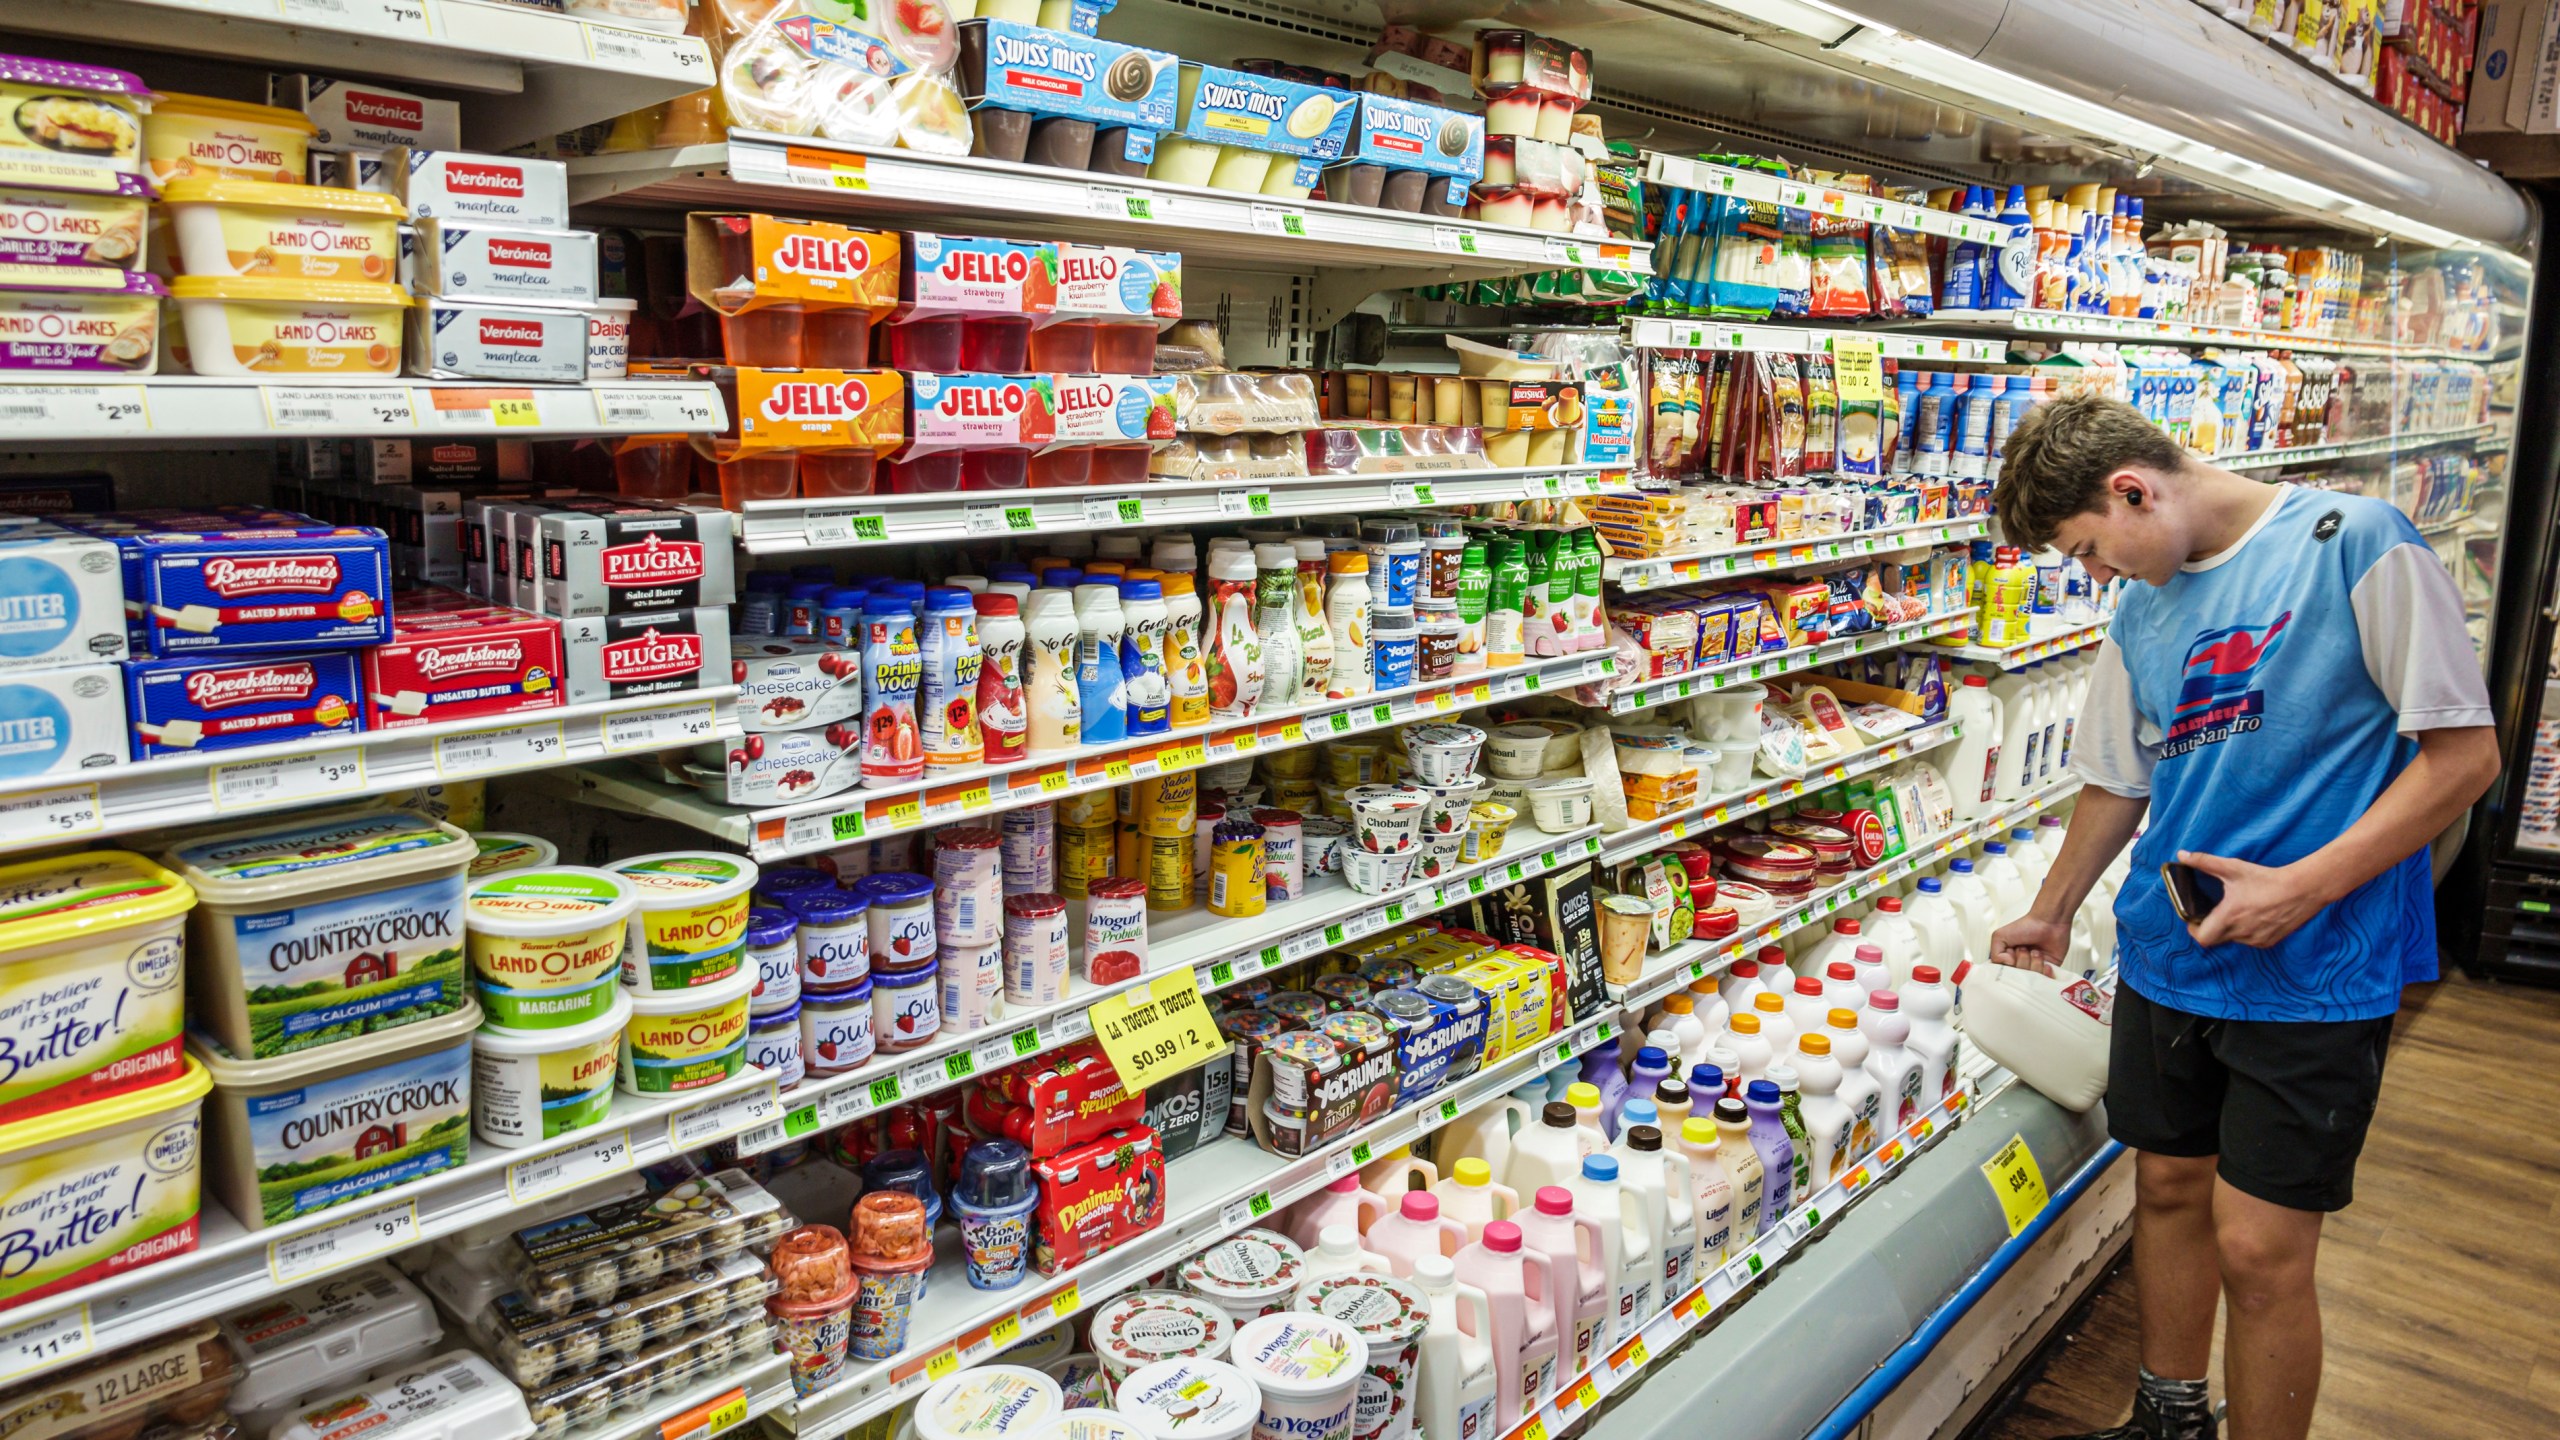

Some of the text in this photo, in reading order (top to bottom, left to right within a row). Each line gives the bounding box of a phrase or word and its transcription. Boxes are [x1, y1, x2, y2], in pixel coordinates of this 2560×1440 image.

[592, 26, 678, 47] PHILADELPHIA SALMON
[816, 29, 872, 68] Nata Pudding
[994, 34, 1096, 82] SWISS MISS
[1022, 77, 1068, 91] MILK CHOCOLATE
[347, 99, 422, 122] Verónica
[1199, 83, 1287, 121] SWISS MISS
[1366, 108, 1432, 139] SWISS MISS
[355, 129, 417, 146] manteca
[189, 142, 283, 166] LAND O LAKES
[447, 168, 524, 190] Verónica
[455, 200, 519, 216] manteca
[1126, 199, 1147, 216] $3.99
[53, 214, 101, 235] LAKES
[1749, 212, 1776, 225] CHEESE
[1816, 216, 1866, 235] Borden
[269, 231, 372, 251] LAND O LAKES
[919, 241, 939, 250] ZERO
[489, 245, 552, 263] Verónica
[301, 257, 340, 276] Honey
[493, 271, 550, 286] manteca
[810, 278, 838, 289] orange
[963, 288, 1005, 300] strawberry
[1069, 292, 1083, 300] kiwi
[68, 318, 118, 337] LAKES
[275, 322, 376, 343] LAND O LAKES
[480, 324, 543, 342] Verónica
[590, 319, 626, 338] Daisy
[306, 348, 345, 368] Honey
[484, 350, 540, 364] manteca
[917, 378, 937, 388] ZERO
[276, 391, 300, 400] LAND
[303, 392, 333, 401] LAKES
[337, 392, 364, 400] HONEY
[802, 422, 832, 433] orange
[962, 422, 1002, 432] strawberry
[1067, 421, 1082, 429] kiwi
[1283, 415, 1302, 423] FLAN
[1521, 413, 1535, 424] Flan
[1432, 461, 1452, 469] SNACKS
[1007, 512, 1029, 528] $3.59
[1118, 502, 1139, 521] $3.59
[854, 518, 880, 538] $3.59
[573, 539, 598, 547] STICKS
[610, 568, 697, 580] PREMIUM EUROPEAN STYLE
[626, 587, 683, 600] Salted Butter
[0, 594, 65, 618] UTTER
[239, 605, 316, 619] SALTED BUTTER
[1306, 655, 1332, 667] Mango
[432, 683, 512, 703] UNSALTED BUTTER
[627, 680, 682, 694] Salted Butter
[738, 677, 832, 697] cheesecake
[221, 712, 294, 730] SALTED BUTTER
[610, 718, 637, 726] PLUGRA
[640, 713, 668, 722] SALTED
[1332, 715, 1349, 731] $2.99
[1376, 707, 1391, 722] $2.99
[221, 759, 284, 774] BREAKSTONE
[755, 749, 838, 772] cheesecake
[750, 772, 772, 781] cherry
[832, 815, 857, 834] $4.89
[1367, 817, 1410, 829] Chobani
[1649, 885, 1668, 901] Sabra
[1562, 890, 1589, 916] OIKOS
[1564, 904, 1590, 925] TRIPLE ZERO
[659, 923, 703, 943] LAND
[1101, 924, 1144, 944] Probiotic
[489, 940, 616, 976] LAND O LAKES
[702, 952, 730, 966] WHIPPED
[40, 977, 104, 1004] believe
[321, 1001, 381, 1022] CALCIUM
[519, 993, 593, 1016] MARGARINE
[1105, 988, 1197, 1039] LA YOGURT YOGURT
[641, 1029, 683, 1047] LAND
[712, 1013, 744, 1036] LAKES
[1017, 1030, 1035, 1052] $1.89
[1132, 1039, 1177, 1072] $0.99
[1186, 1028, 1200, 1046] 2
[92, 1046, 178, 1083] the ORIGINAL
[672, 1063, 728, 1080] SALTED BUTTER
[684, 1060, 716, 1073] WHIPPED
[950, 1055, 970, 1075] $1.89
[1403, 1054, 1448, 1089] OREO
[1206, 1070, 1229, 1091] 15g
[875, 1080, 896, 1103] $1.89
[1169, 1111, 1200, 1131] ZERO
[59, 1165, 121, 1199] believe
[331, 1170, 391, 1195] CALCIUM
[2010, 1166, 2028, 1193] $3.99
[1058, 1183, 1125, 1234] Danimals
[1741, 1198, 1762, 1219] KEFIR
[980, 1230, 1021, 1248] YURT
[986, 1223, 1015, 1238] BON
[1079, 1220, 1112, 1239] Strawberry
[1704, 1227, 1730, 1249] KEFIR
[109, 1226, 193, 1267] the ORIGINAL
[1234, 1241, 1264, 1279] Chobani
[1335, 1288, 1377, 1323] Chobani
[96, 1355, 188, 1406] 12 LARGE
